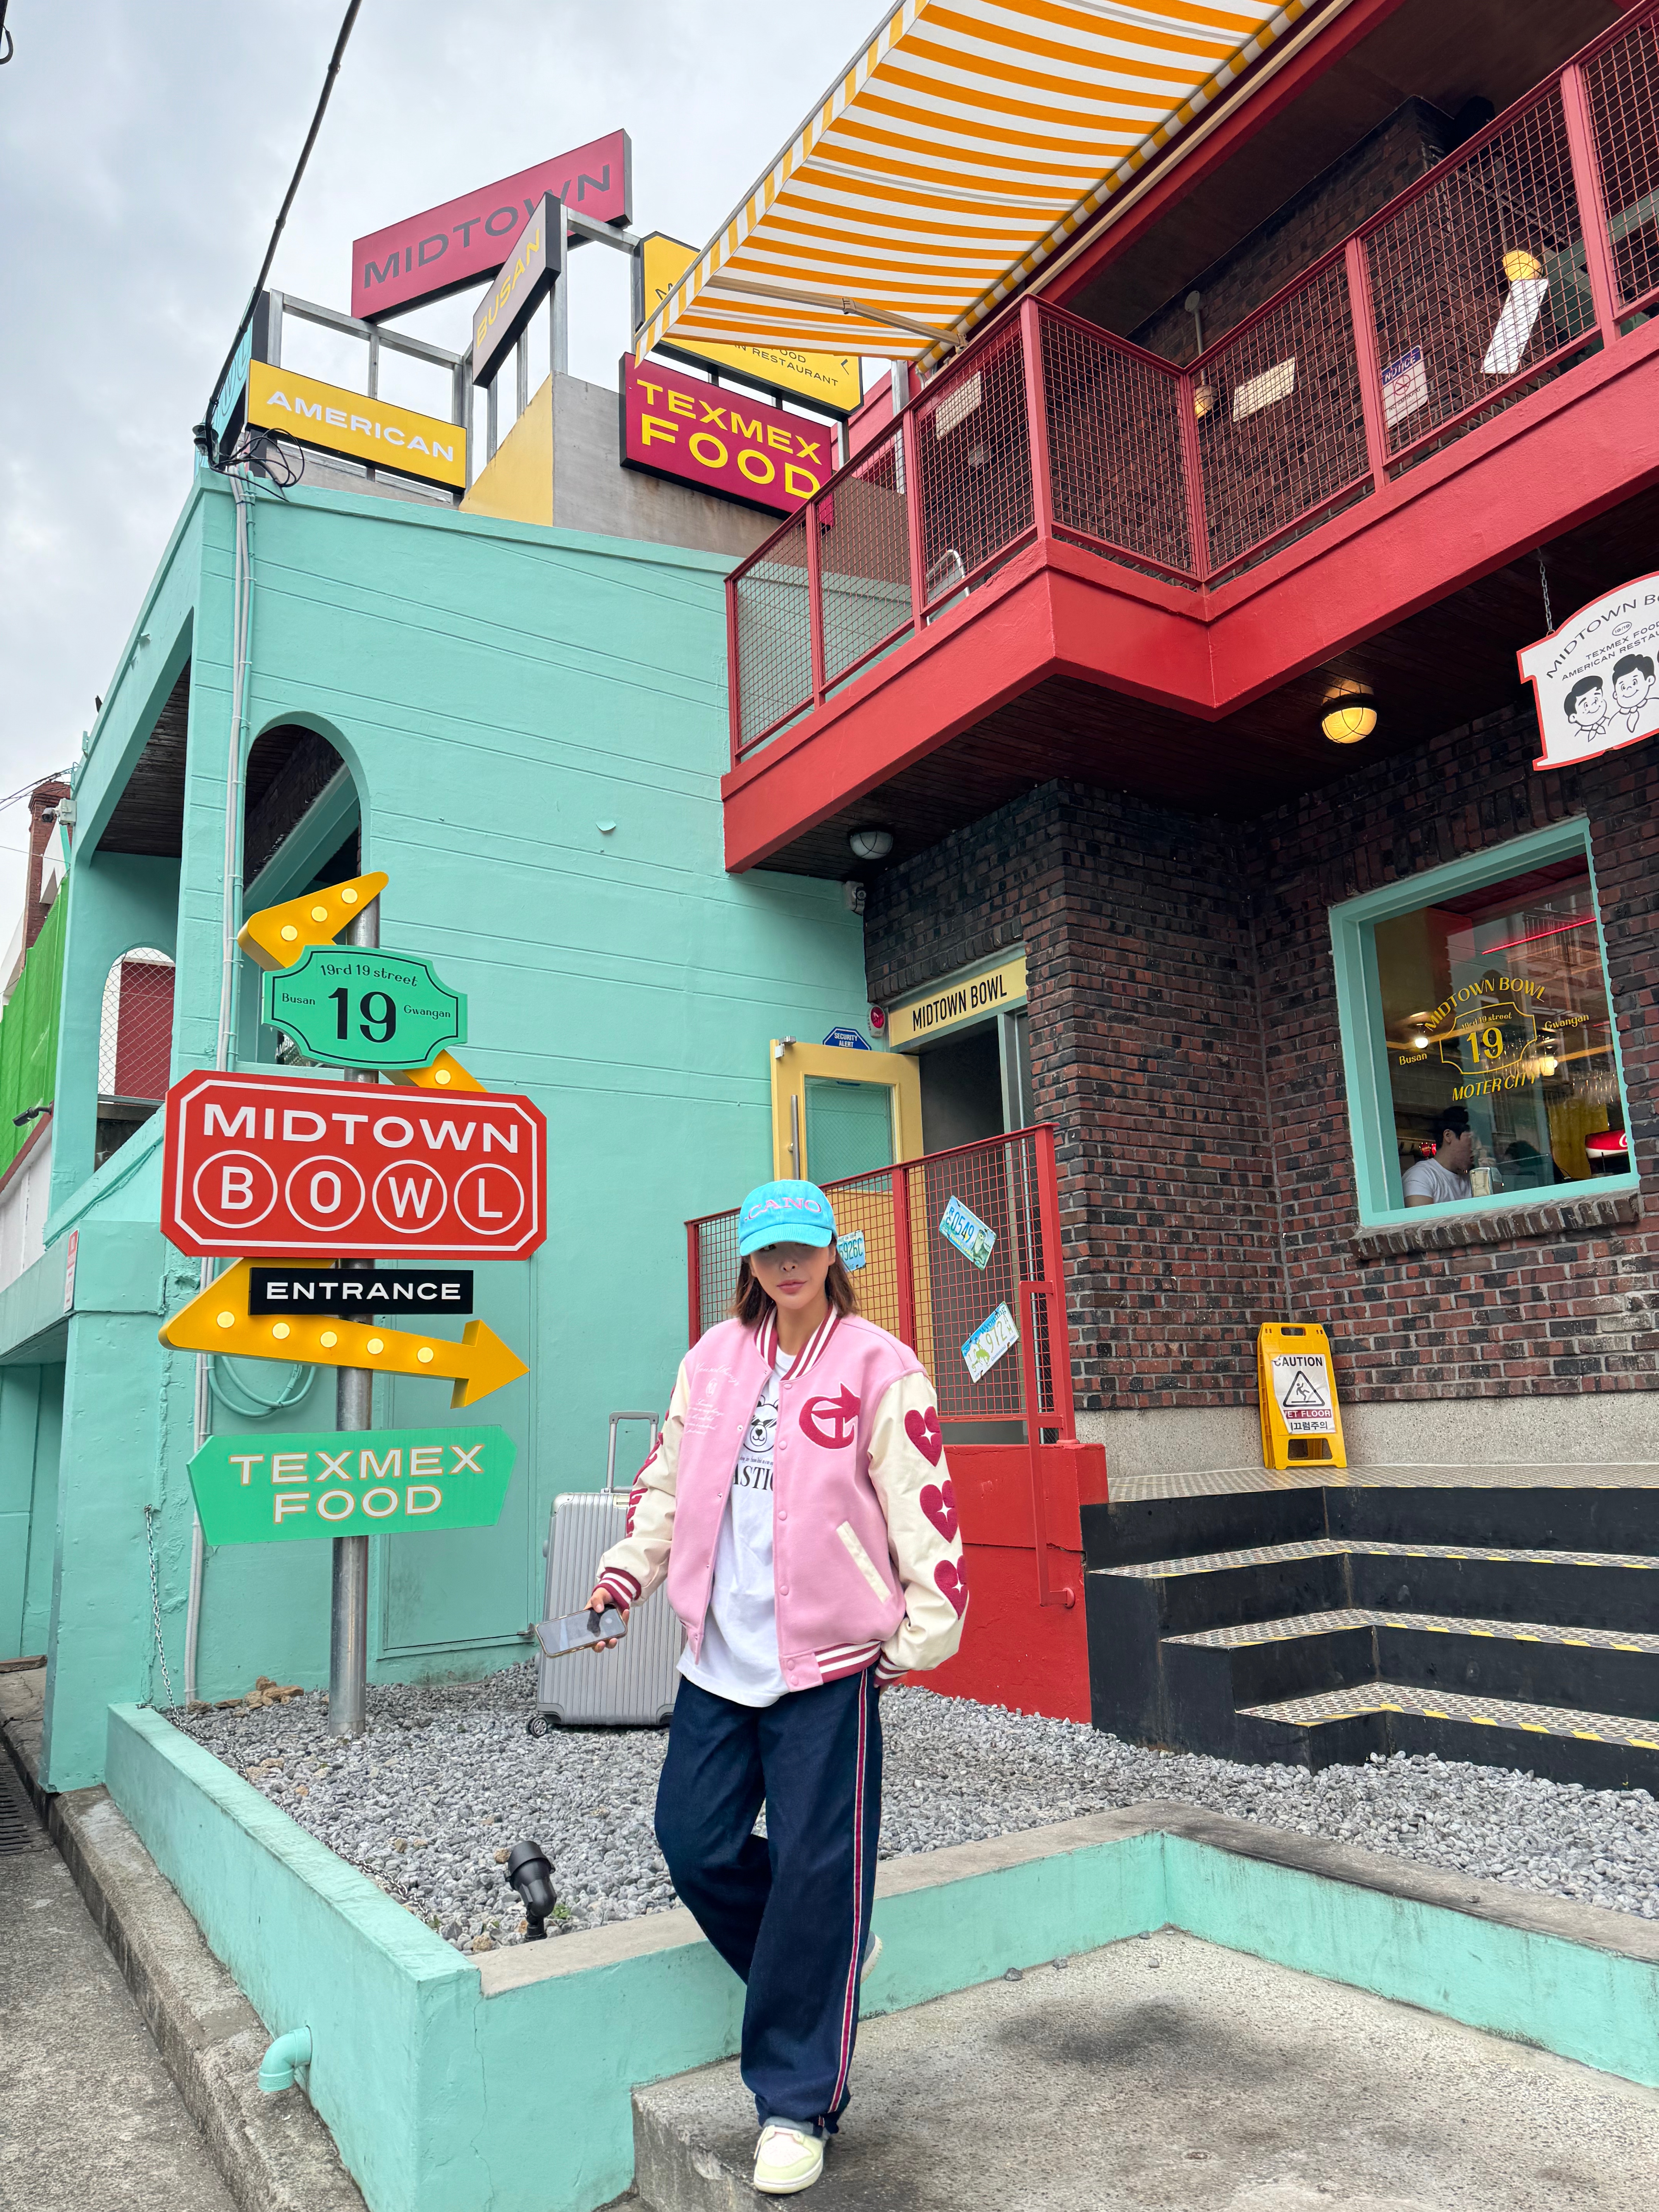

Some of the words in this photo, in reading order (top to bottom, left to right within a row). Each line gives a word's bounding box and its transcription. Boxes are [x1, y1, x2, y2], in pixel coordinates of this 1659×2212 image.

[477, 228, 539, 349] BUSAN
[753, 347, 838, 386] RESTAURANT
[779, 349, 806, 363] OOD
[1385, 356, 1416, 382] NOTICE
[266, 391, 453, 462] AMERICAN
[637, 379, 822, 465] TEXMEX
[642, 413, 820, 500] FOOD
[1546, 599, 1637, 679] MIDTOWN
[1645, 594, 1659, 605] B
[1586, 636, 1628, 660] TEXMEX
[1562, 651, 1615, 681] AMERICAN
[320, 964, 352, 976] 19rd
[356, 964, 370, 976] 19
[373, 967, 418, 987] street
[282, 993, 315, 1005] Busan
[404, 1005, 451, 1020] Gwangan
[913, 989, 966, 1032] MIDTOWN
[971, 974, 1007, 1009] BOWL
[1424, 978, 1494, 1032] MIDTOWN
[1499, 977, 1547, 1003] BOWL
[328, 987, 396, 1043] 19
[1544, 1014, 1590, 1030] Gwangan
[834, 1032, 858, 1041] SECURITY
[839, 1040, 854, 1048] ALERT
[1467, 1027, 1504, 1063] 19
[1399, 1053, 1427, 1065] Busan
[1452, 1078, 1501, 1101] MOTER
[1504, 1072, 1535, 1090] CITY
[203, 1103, 518, 1154] MIDTOWN
[221, 1166, 502, 1218] BOWL
[951, 1212, 974, 1243] 0549
[266, 1281, 461, 1300] ENTRANCE
[1274, 1357, 1323, 1366] CAUTION
[229, 1444, 485, 1486] TEXMEX
[273, 1485, 443, 1524] FOOD
